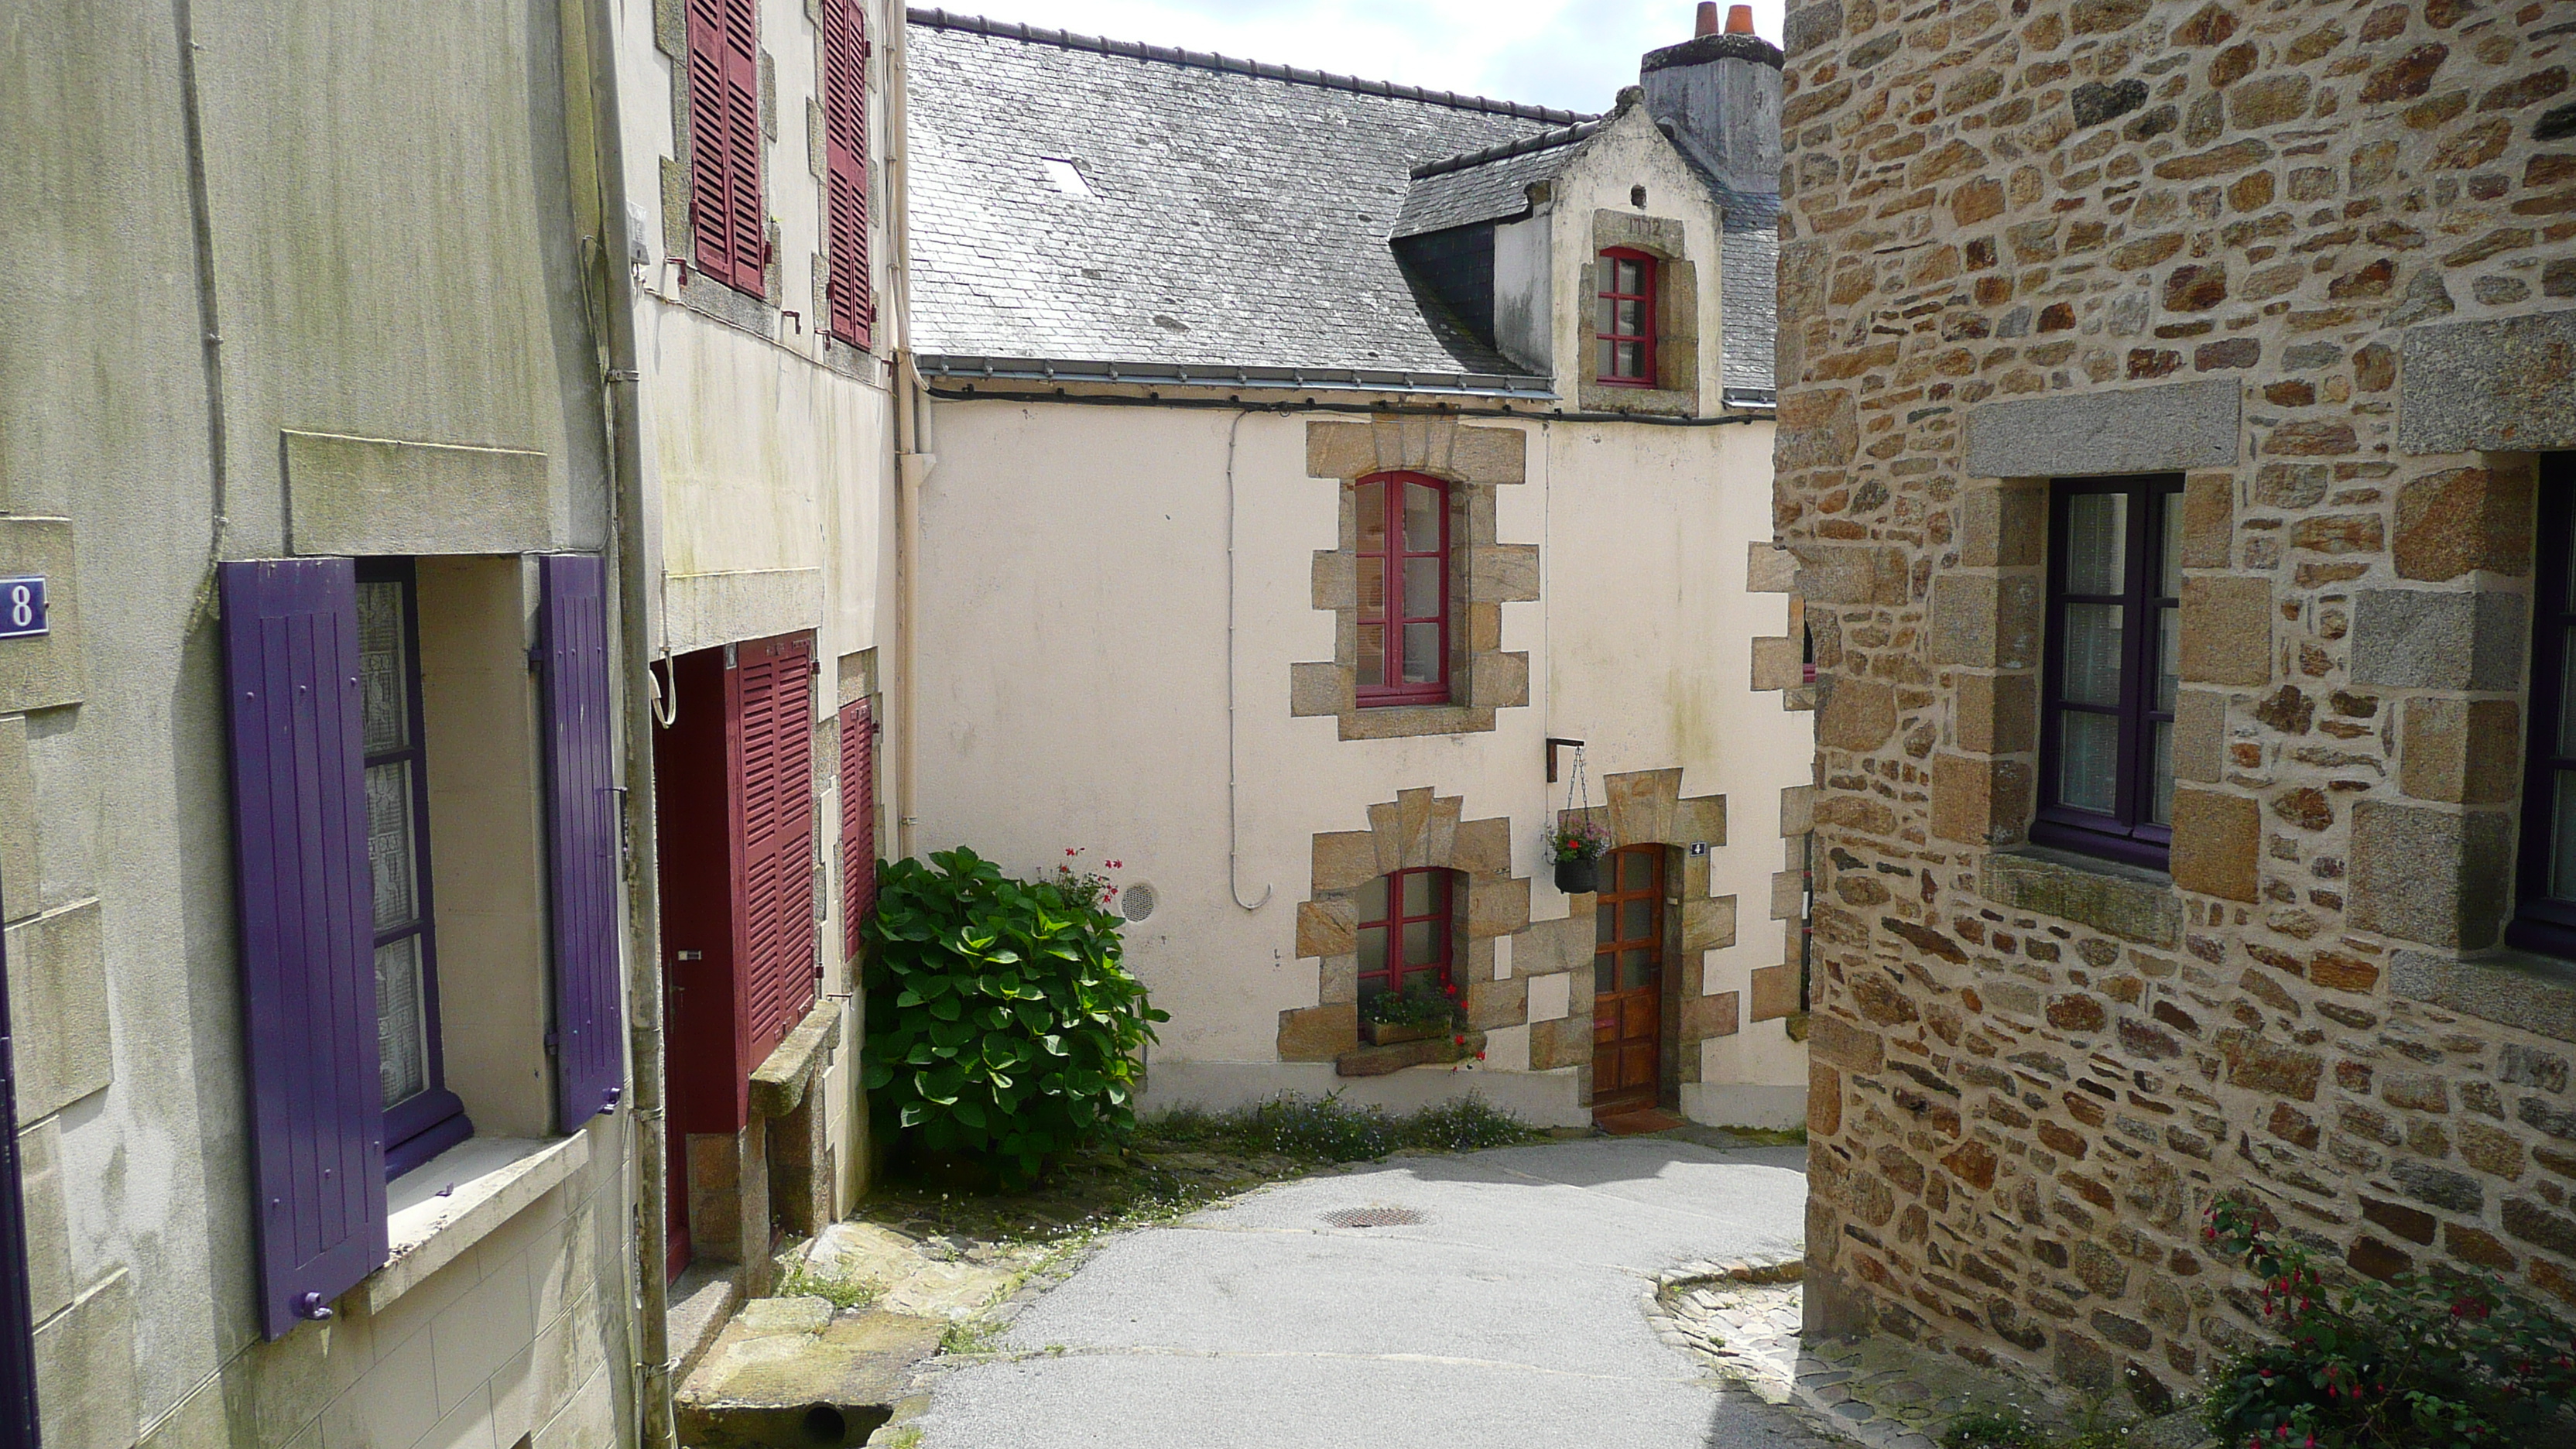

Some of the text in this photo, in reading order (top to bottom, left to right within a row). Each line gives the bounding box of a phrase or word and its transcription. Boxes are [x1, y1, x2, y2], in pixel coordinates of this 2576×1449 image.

[12, 585, 32, 627] 8
[729, 647, 735, 665] 6
[1694, 844, 1701, 854] 4
